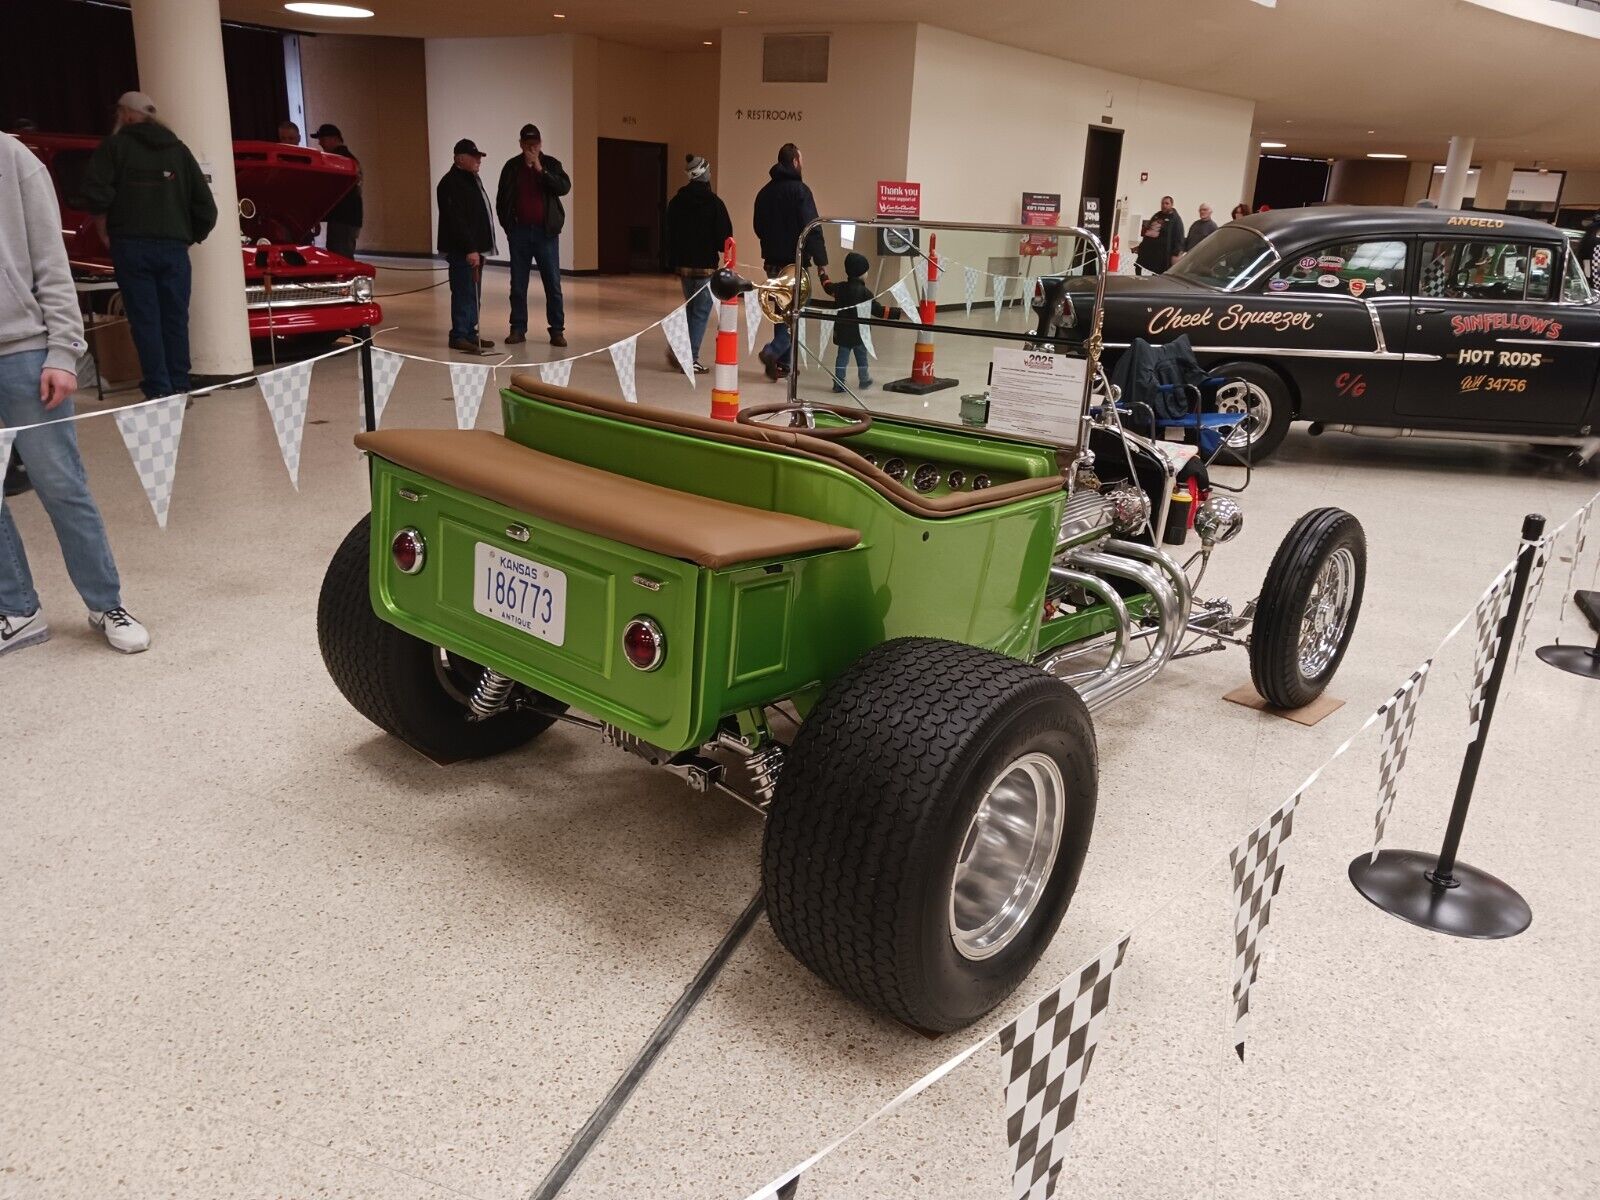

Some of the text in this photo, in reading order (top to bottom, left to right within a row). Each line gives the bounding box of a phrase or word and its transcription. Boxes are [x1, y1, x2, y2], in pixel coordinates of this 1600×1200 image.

[747, 110, 803, 121] RESTROOMS
[880, 185, 918, 197] Thank you
[1447, 216, 1505, 228] ANGELO
[1302, 258, 1315, 267] STP
[1451, 313, 1563, 339] SINFELLOW'S
[1029, 354, 1054, 364] 2025
[1459, 349, 1542, 367] HOT RODS
[1485, 377, 1527, 392] 34756
[500, 556, 538, 580] KANSAS
[487, 567, 553, 624] 186773
[501, 611, 532, 630] ANTIQUE
